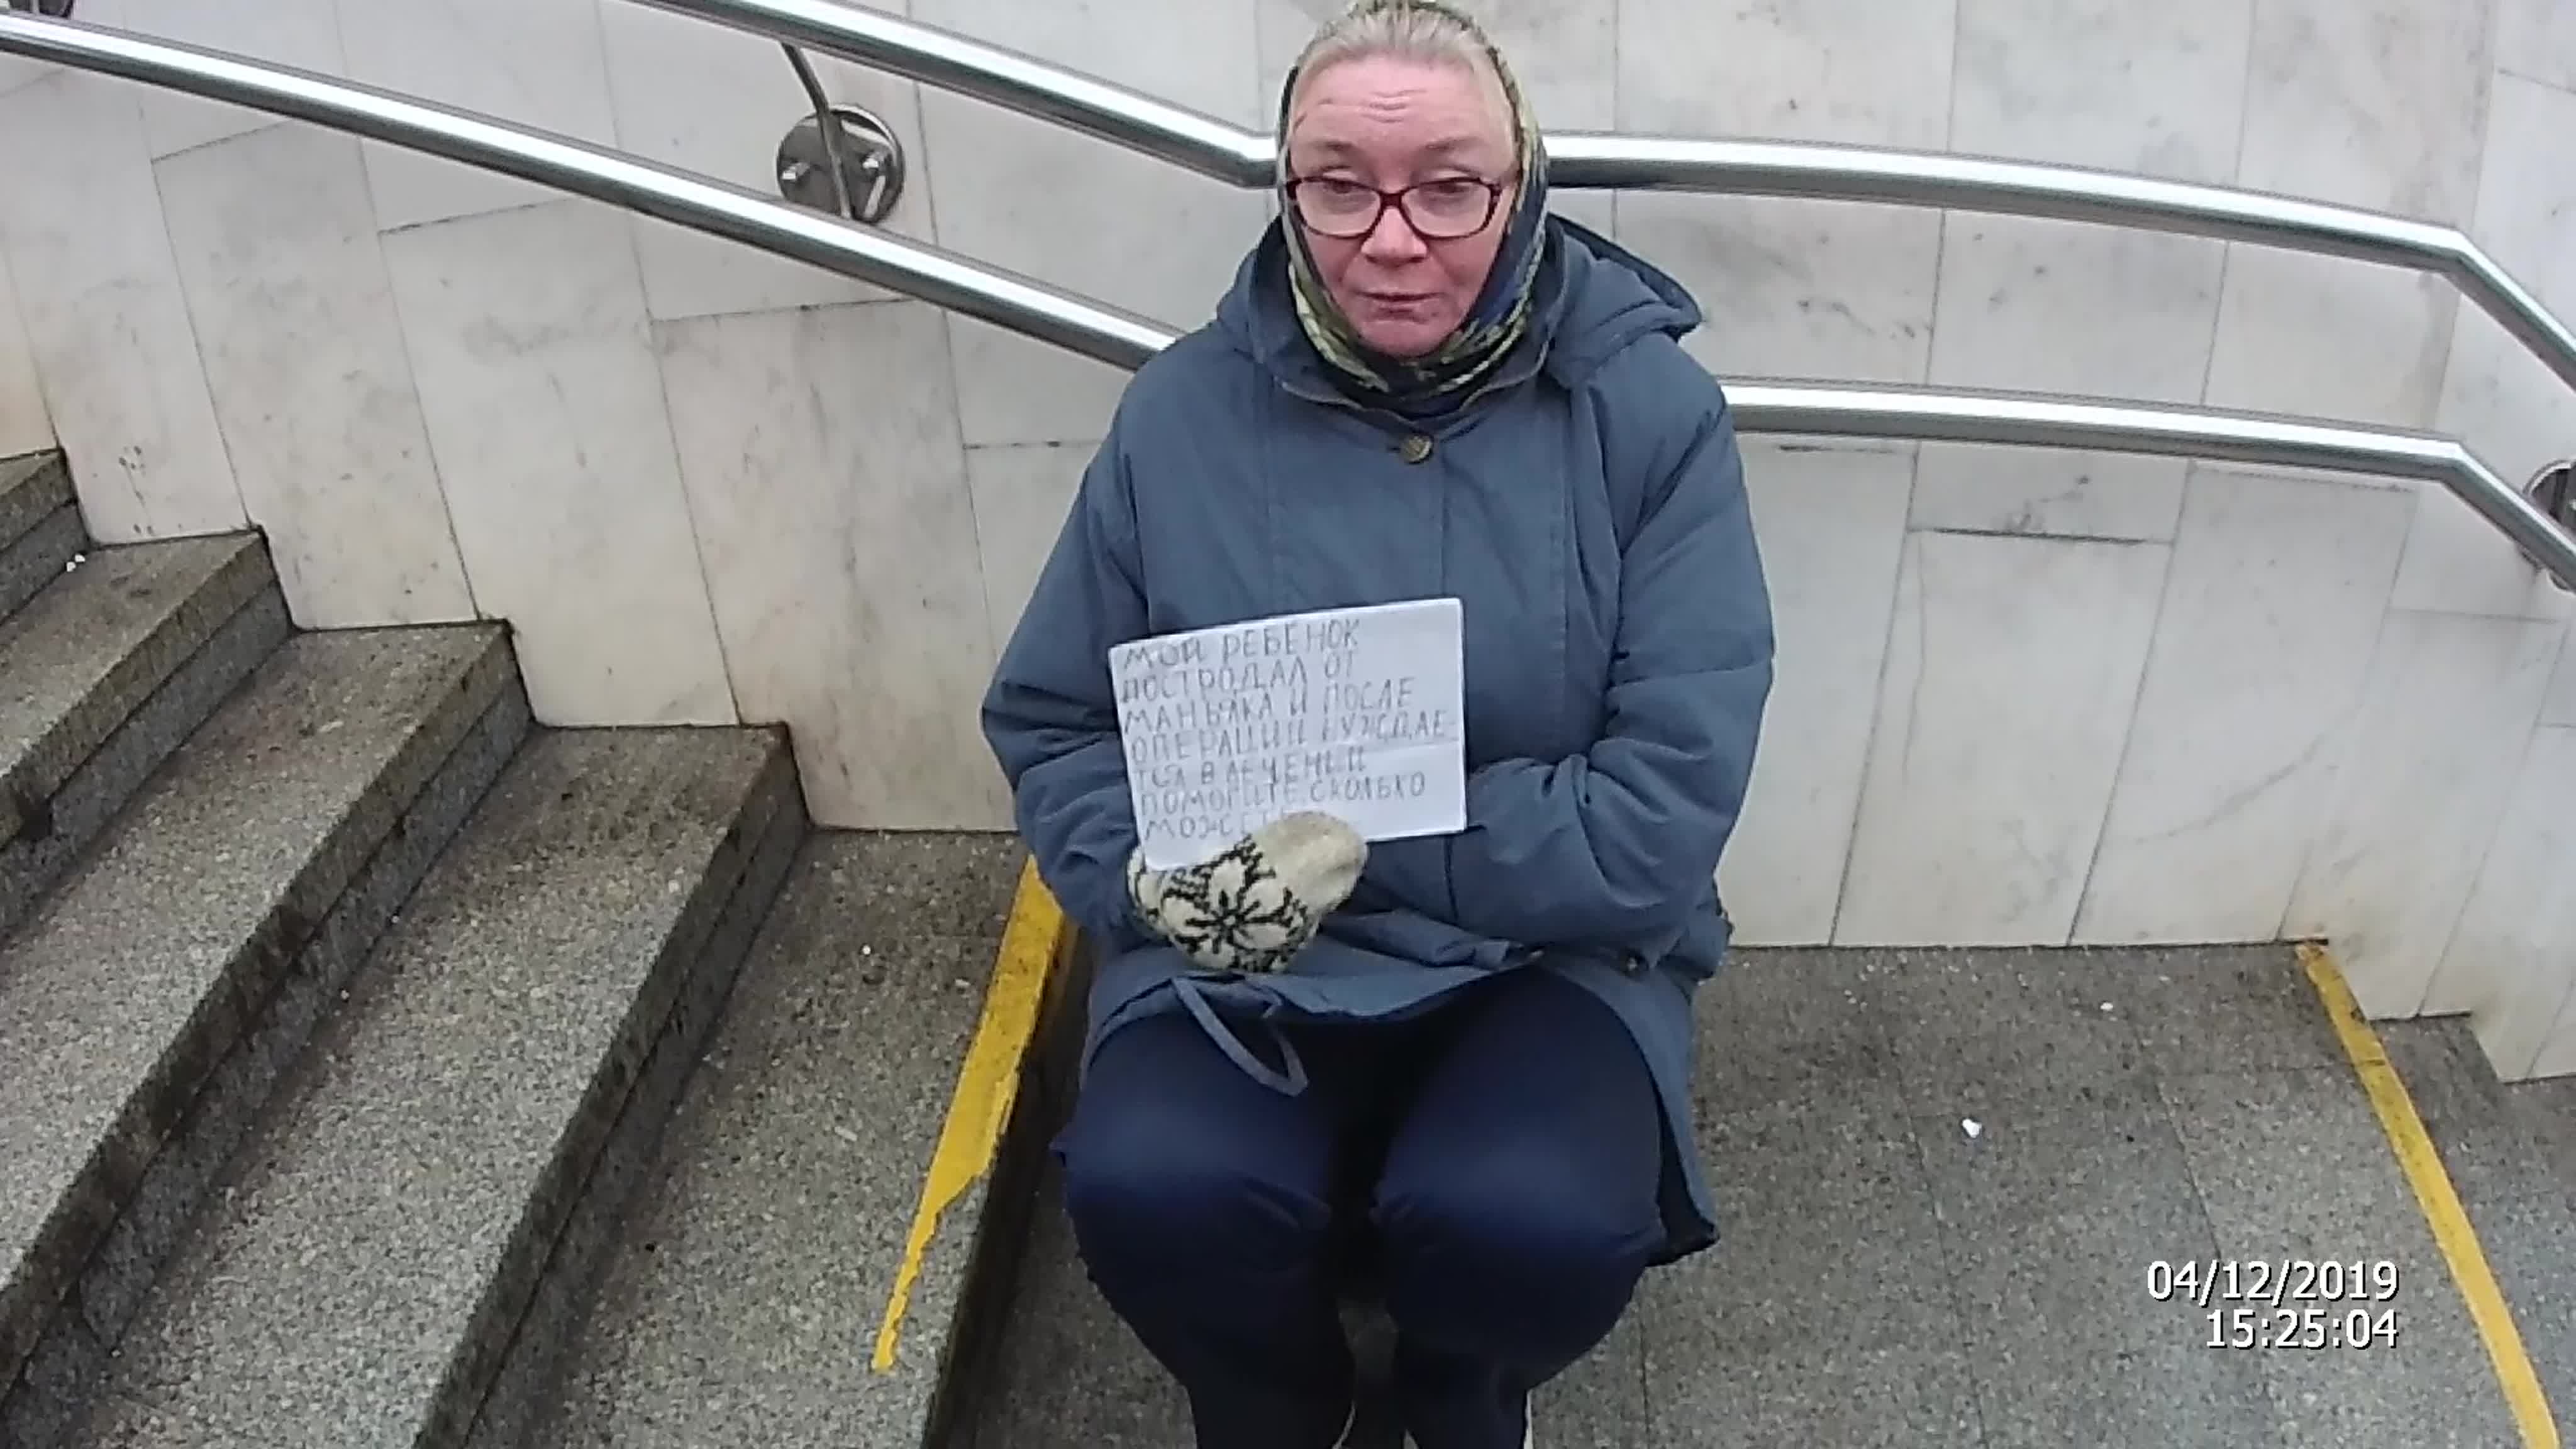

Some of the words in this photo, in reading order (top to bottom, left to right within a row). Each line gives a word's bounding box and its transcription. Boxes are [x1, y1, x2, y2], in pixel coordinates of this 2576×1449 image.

[1221, 618, 1360, 664] РЕБЕНОК
[1324, 648, 1354, 679] ОТ
[1123, 691, 1272, 735] МАНЬЯКА
[1290, 687, 1308, 716] И
[1323, 676, 1416, 715] ПОСЛЕ
[1200, 760, 1215, 785] В
